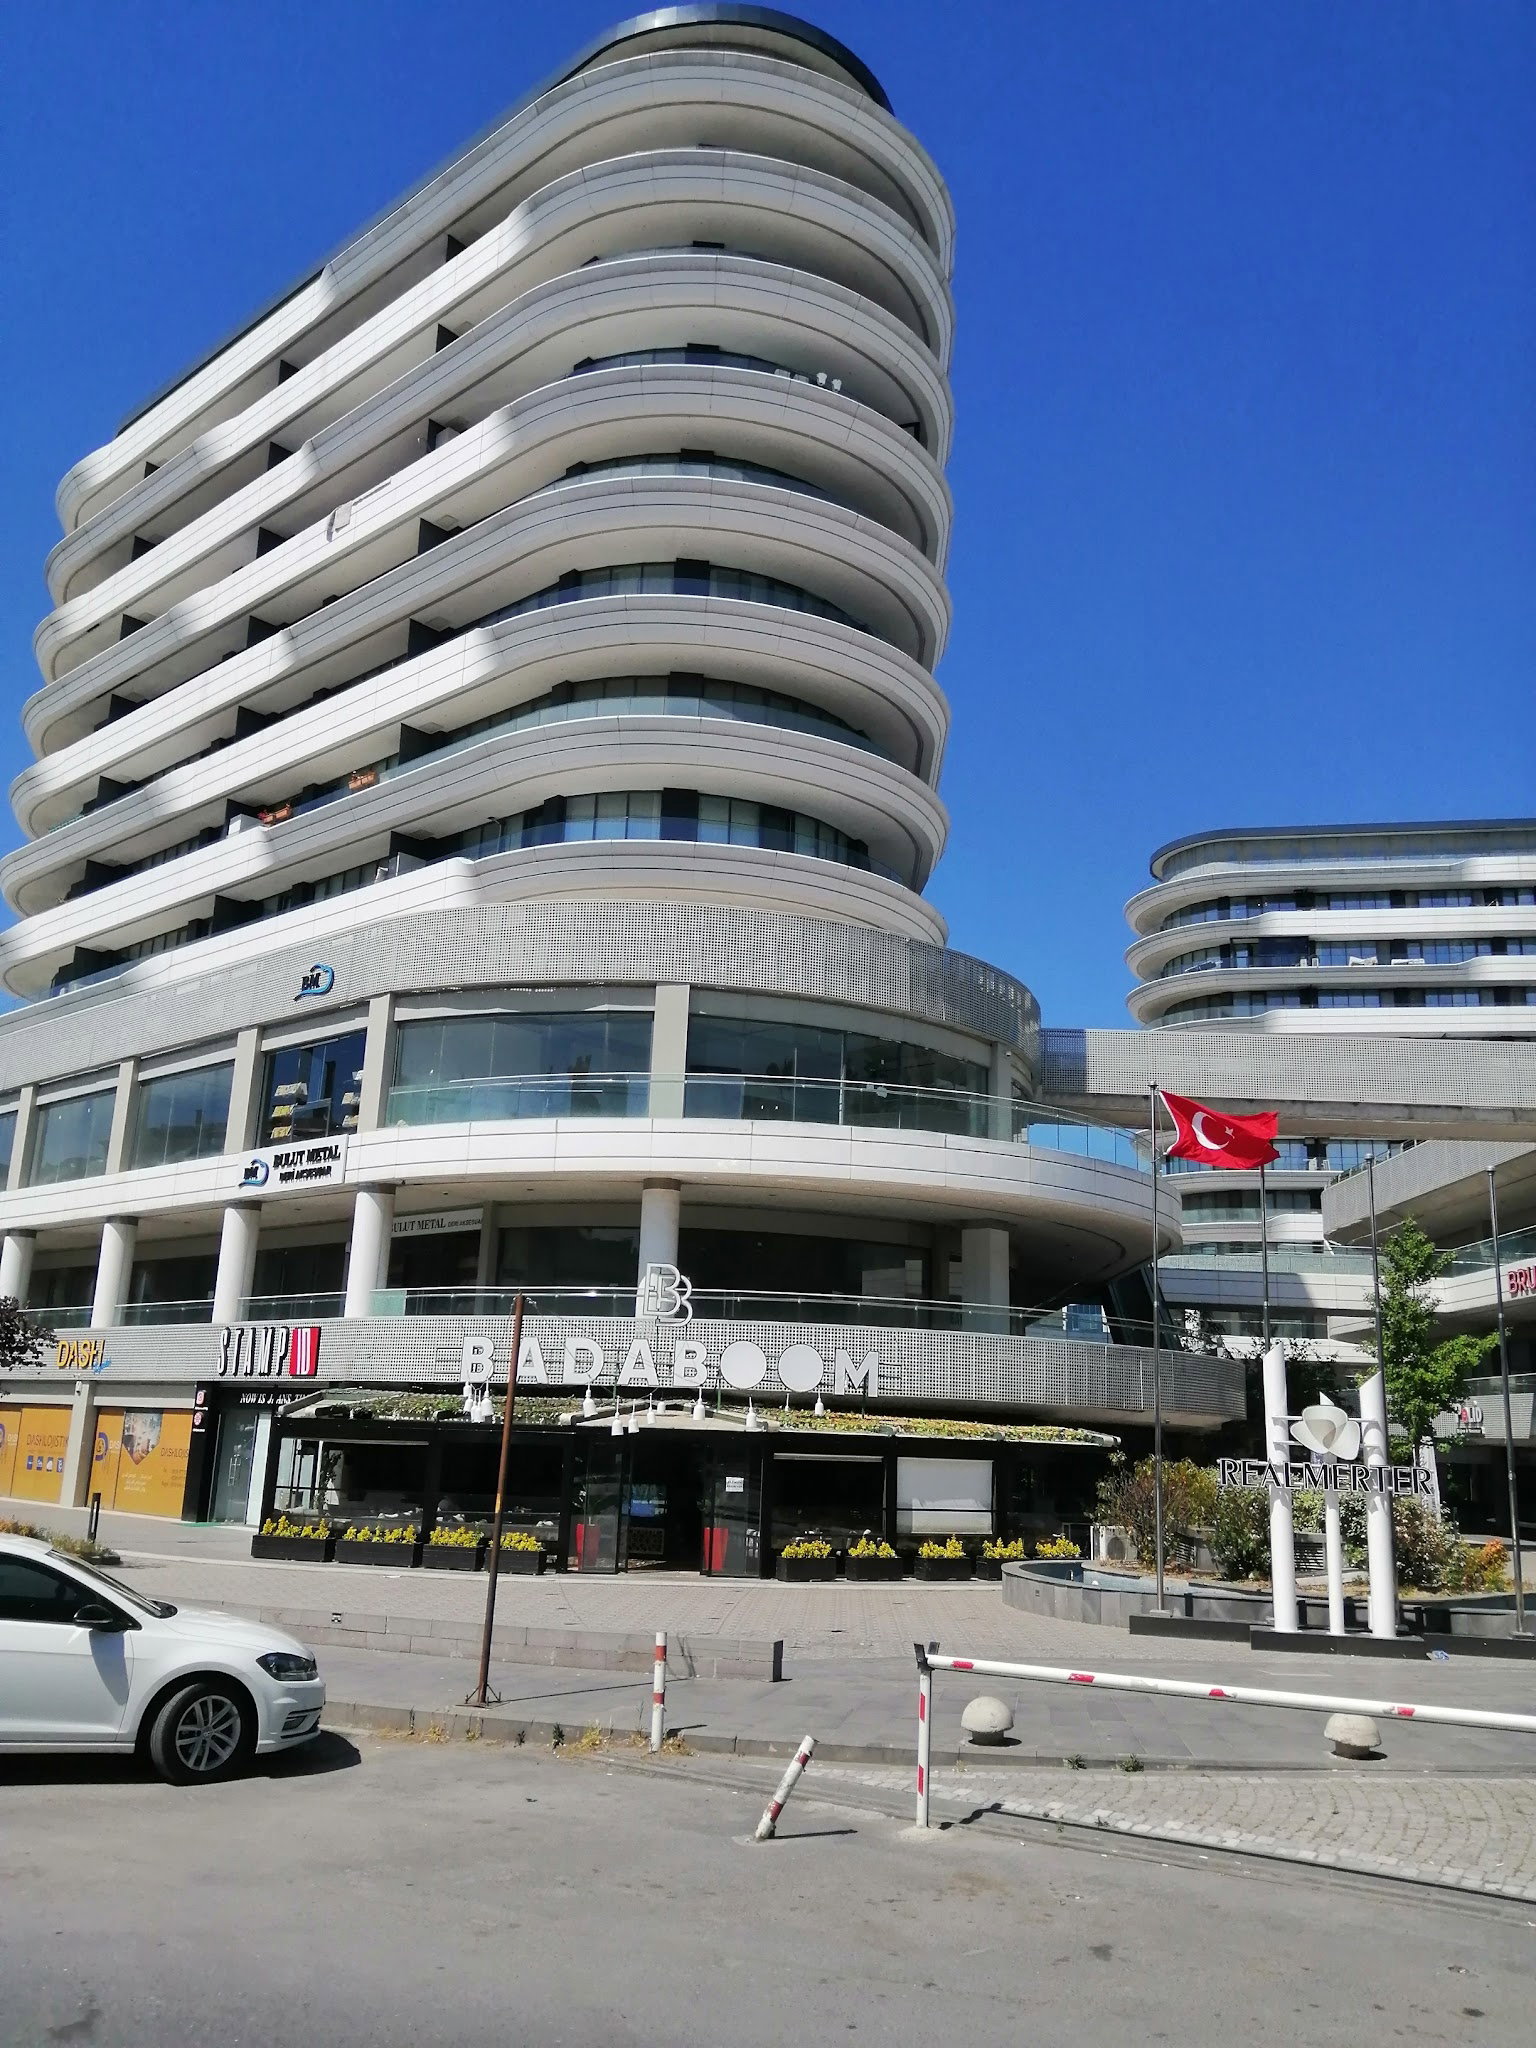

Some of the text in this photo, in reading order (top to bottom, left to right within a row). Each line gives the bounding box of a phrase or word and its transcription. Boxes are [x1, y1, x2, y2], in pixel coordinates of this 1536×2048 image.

[273, 1144, 341, 1170] BULUT METAL
[392, 1221, 416, 1233] ULUT
[417, 1218, 446, 1231] METAL
[57, 1338, 105, 1368] DASH
[460, 1336, 880, 1398] BADABOOM
[1219, 1458, 1433, 1496] REALMERTER
